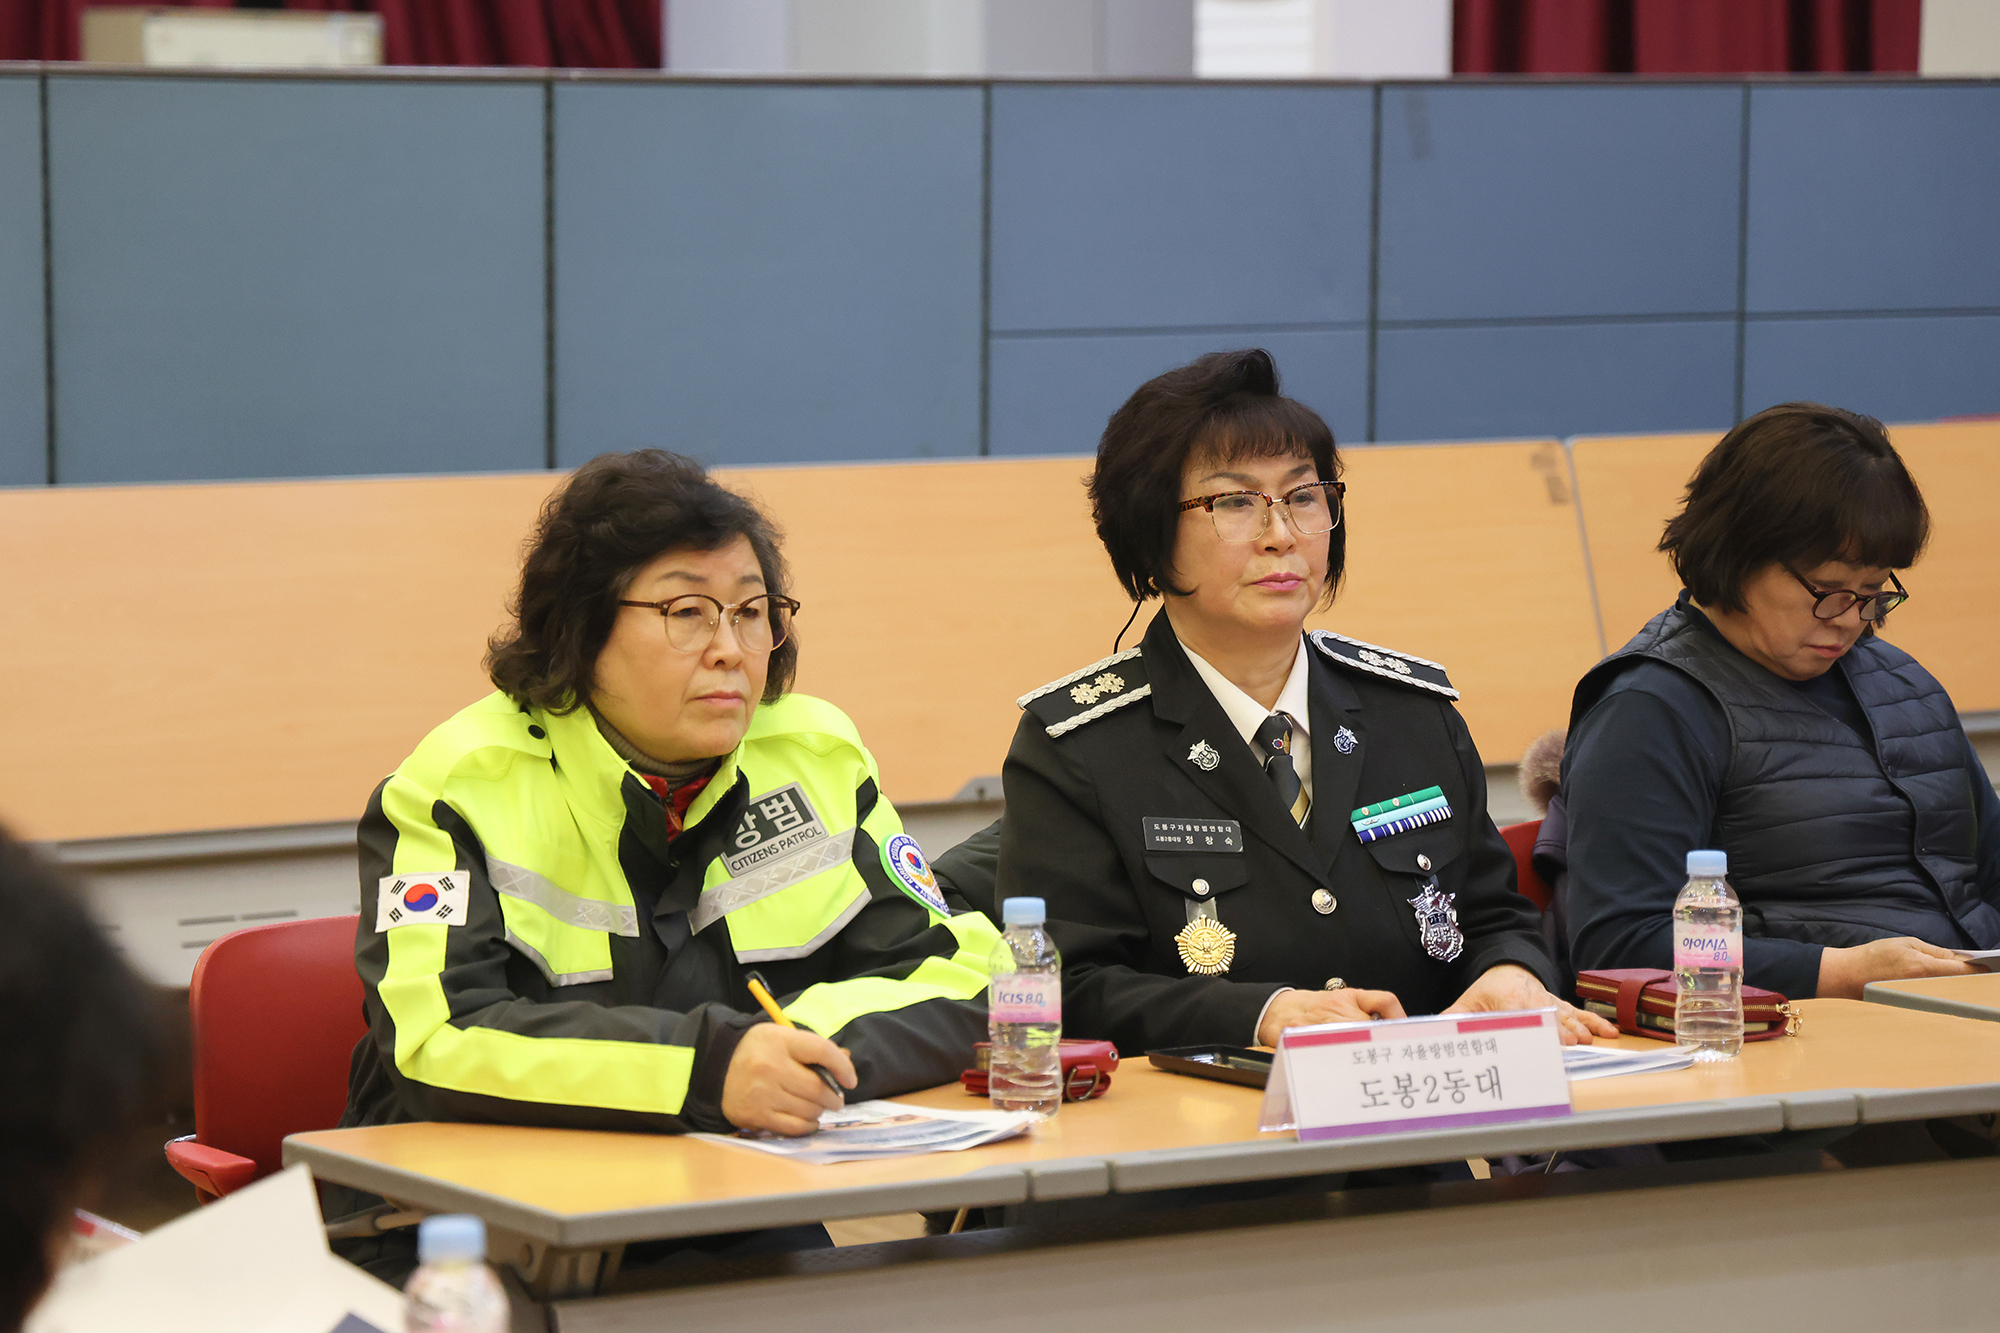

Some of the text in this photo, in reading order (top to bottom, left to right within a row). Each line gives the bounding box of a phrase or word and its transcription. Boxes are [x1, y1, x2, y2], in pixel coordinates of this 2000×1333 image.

[731, 826, 822, 871] CITIZENS PATROL
[1682, 937, 1728, 951] 아이시스
[1713, 951, 1728, 961] 8.0
[1352, 1038, 1498, 1065] 도봉구 자율방범연합대
[1360, 1065, 1503, 1109] 도봉2동대
